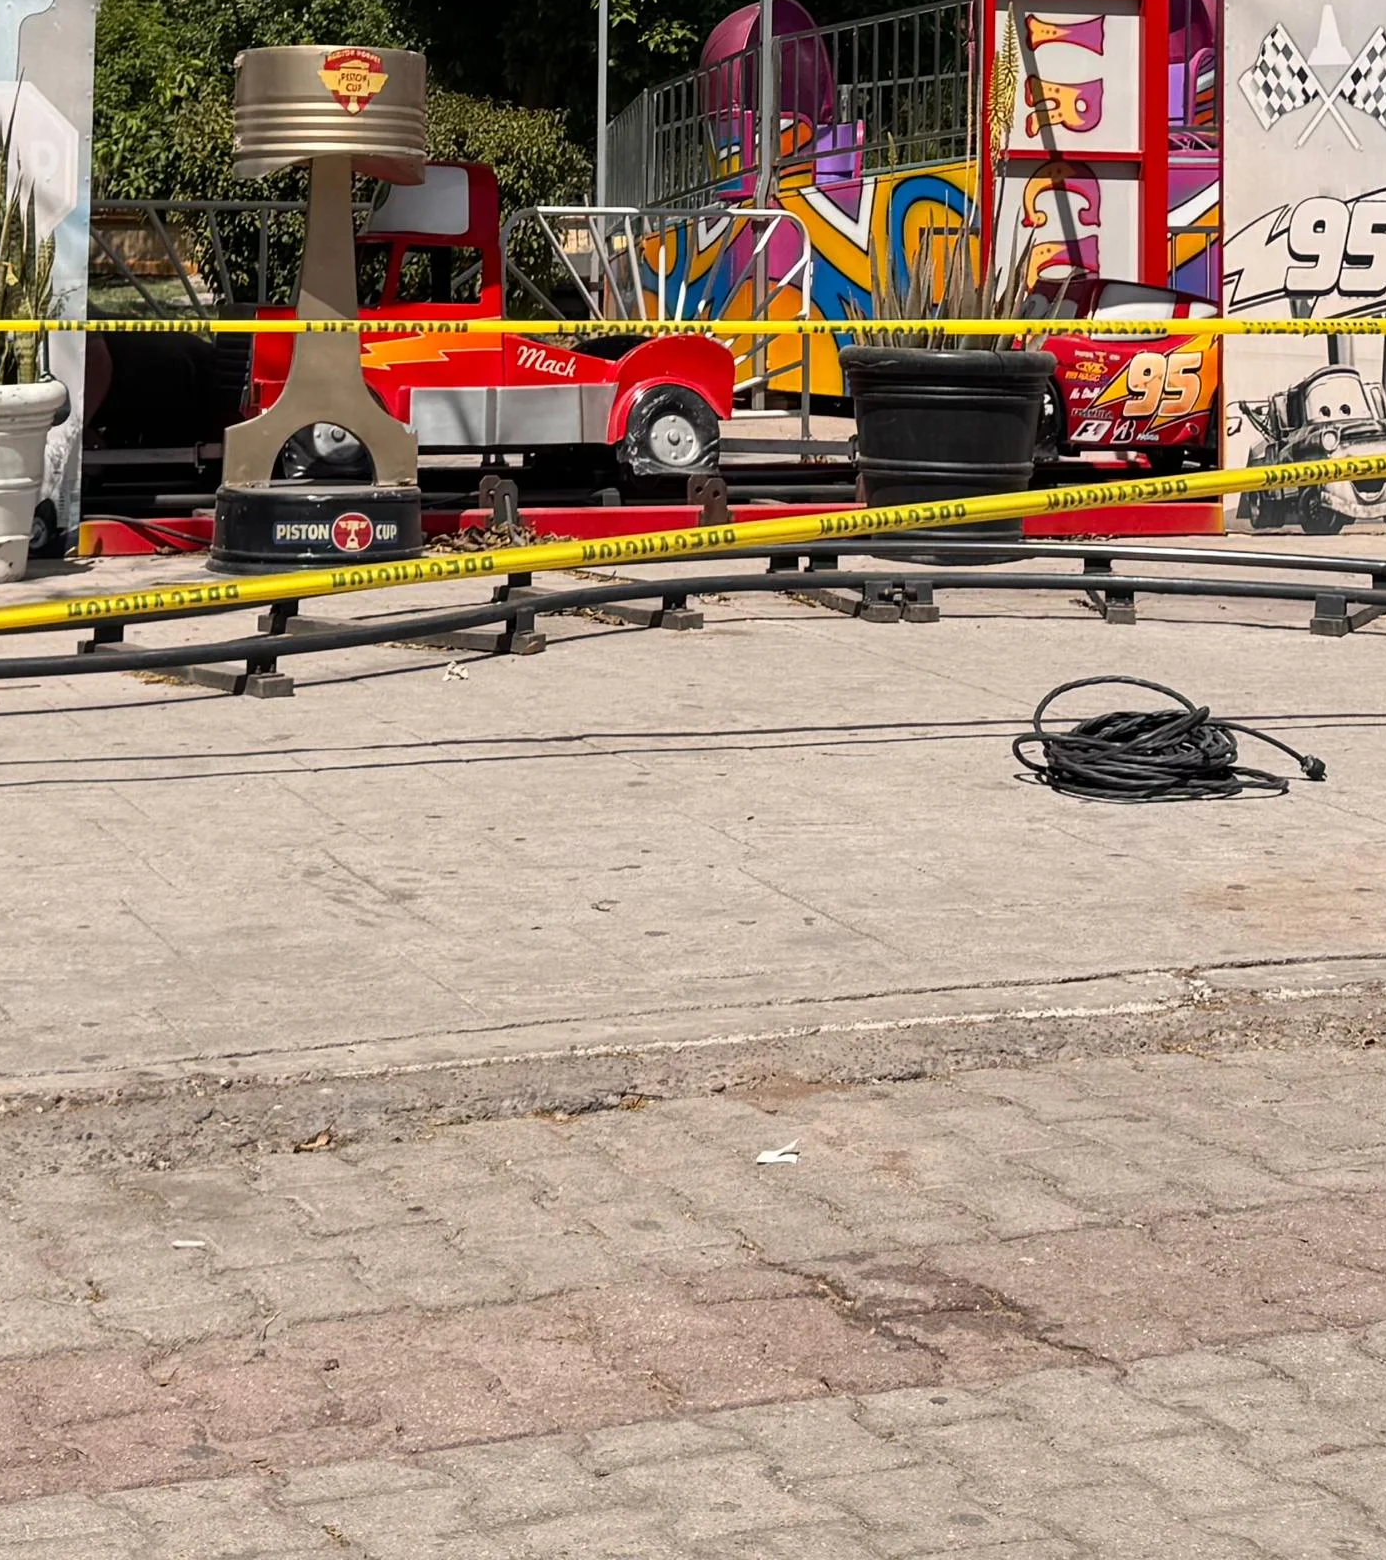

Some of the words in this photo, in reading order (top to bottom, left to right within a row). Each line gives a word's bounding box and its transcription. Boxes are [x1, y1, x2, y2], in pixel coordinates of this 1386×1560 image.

[517, 345, 577, 377] Mack
[1123, 351, 1204, 417] 95
[276, 524, 329, 540] PISTON
[375, 524, 397, 540] CUP
